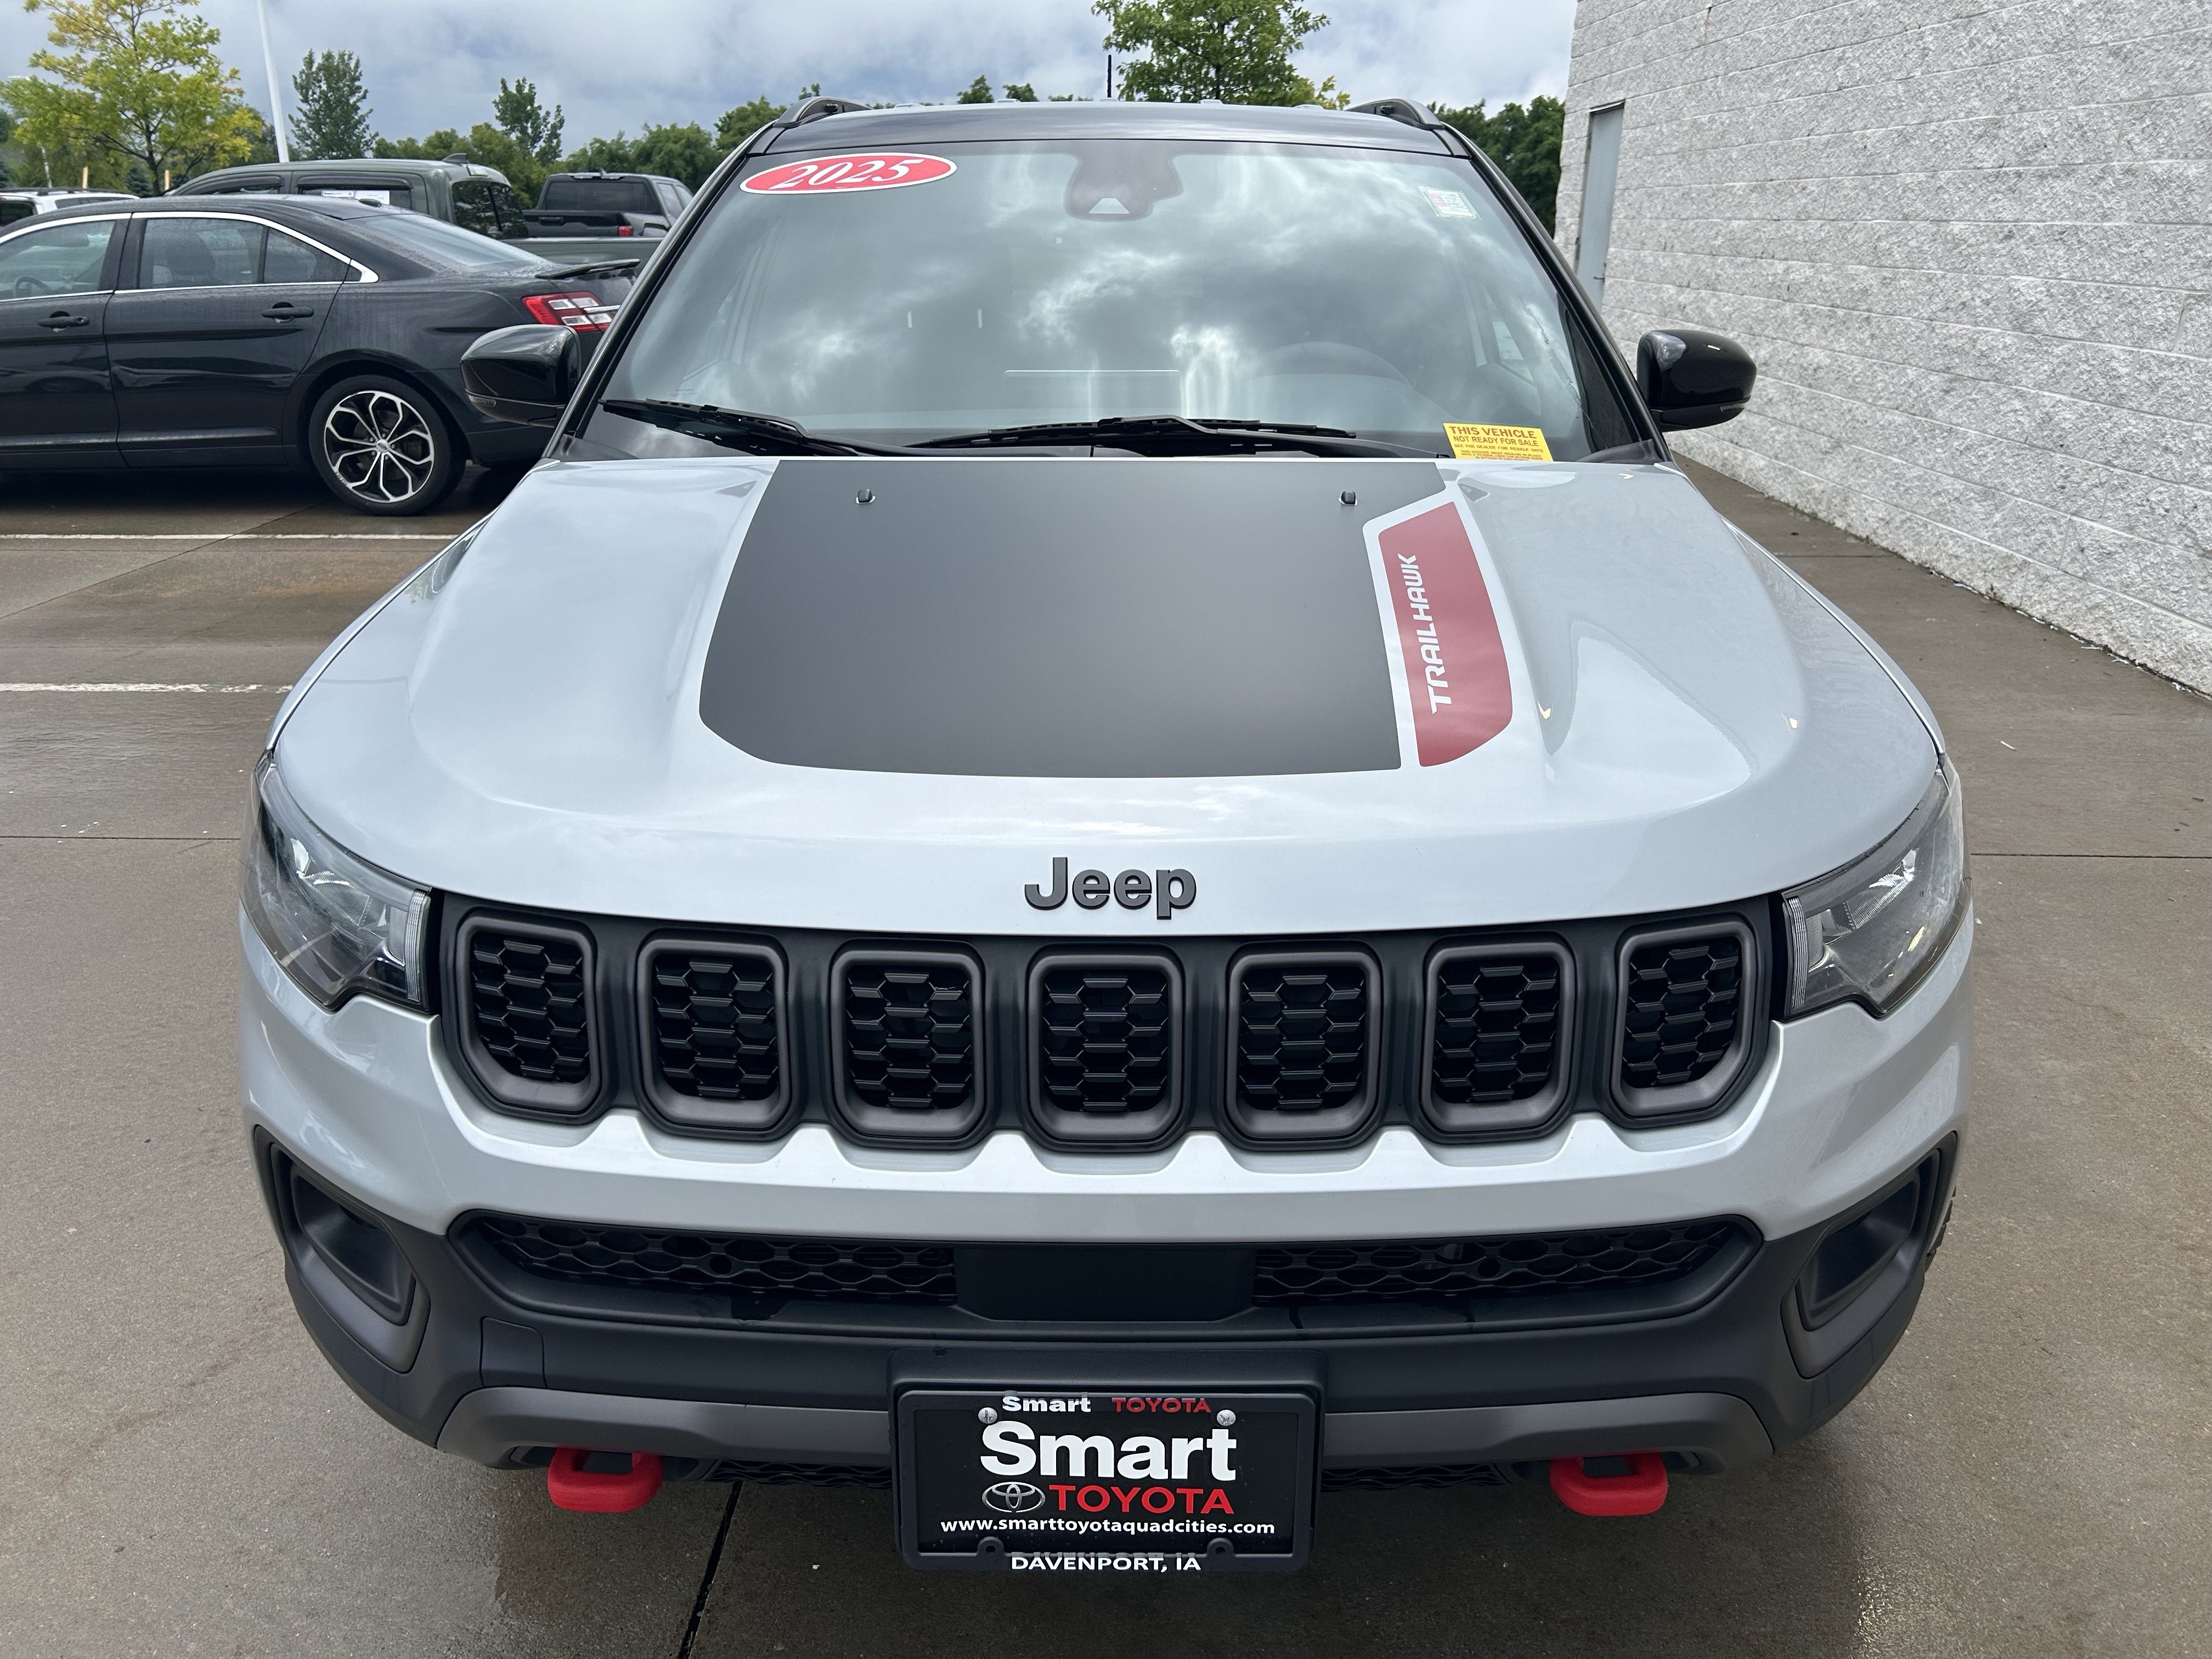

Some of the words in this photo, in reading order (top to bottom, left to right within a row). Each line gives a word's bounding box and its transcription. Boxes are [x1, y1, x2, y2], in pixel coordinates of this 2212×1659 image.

[768, 159, 925, 190] 2025
[1449, 426, 1480, 435] THIS
[1481, 427, 1537, 439] VEHICLE
[1397, 553, 1452, 714] TRAILHAWK
[1024, 857, 1197, 920] Jeep
[1002, 1395, 1092, 1413] Smart
[1111, 1397, 1211, 1413] TOYOTA
[980, 1420, 1237, 1482] Smart
[1048, 1484, 1234, 1514] TOYOTA
[940, 1516, 1276, 1534] www.smarttoyotaquadcities.com
[1011, 1555, 1168, 1573] DAVENPORT,
[1176, 1555, 1201, 1571] IA
